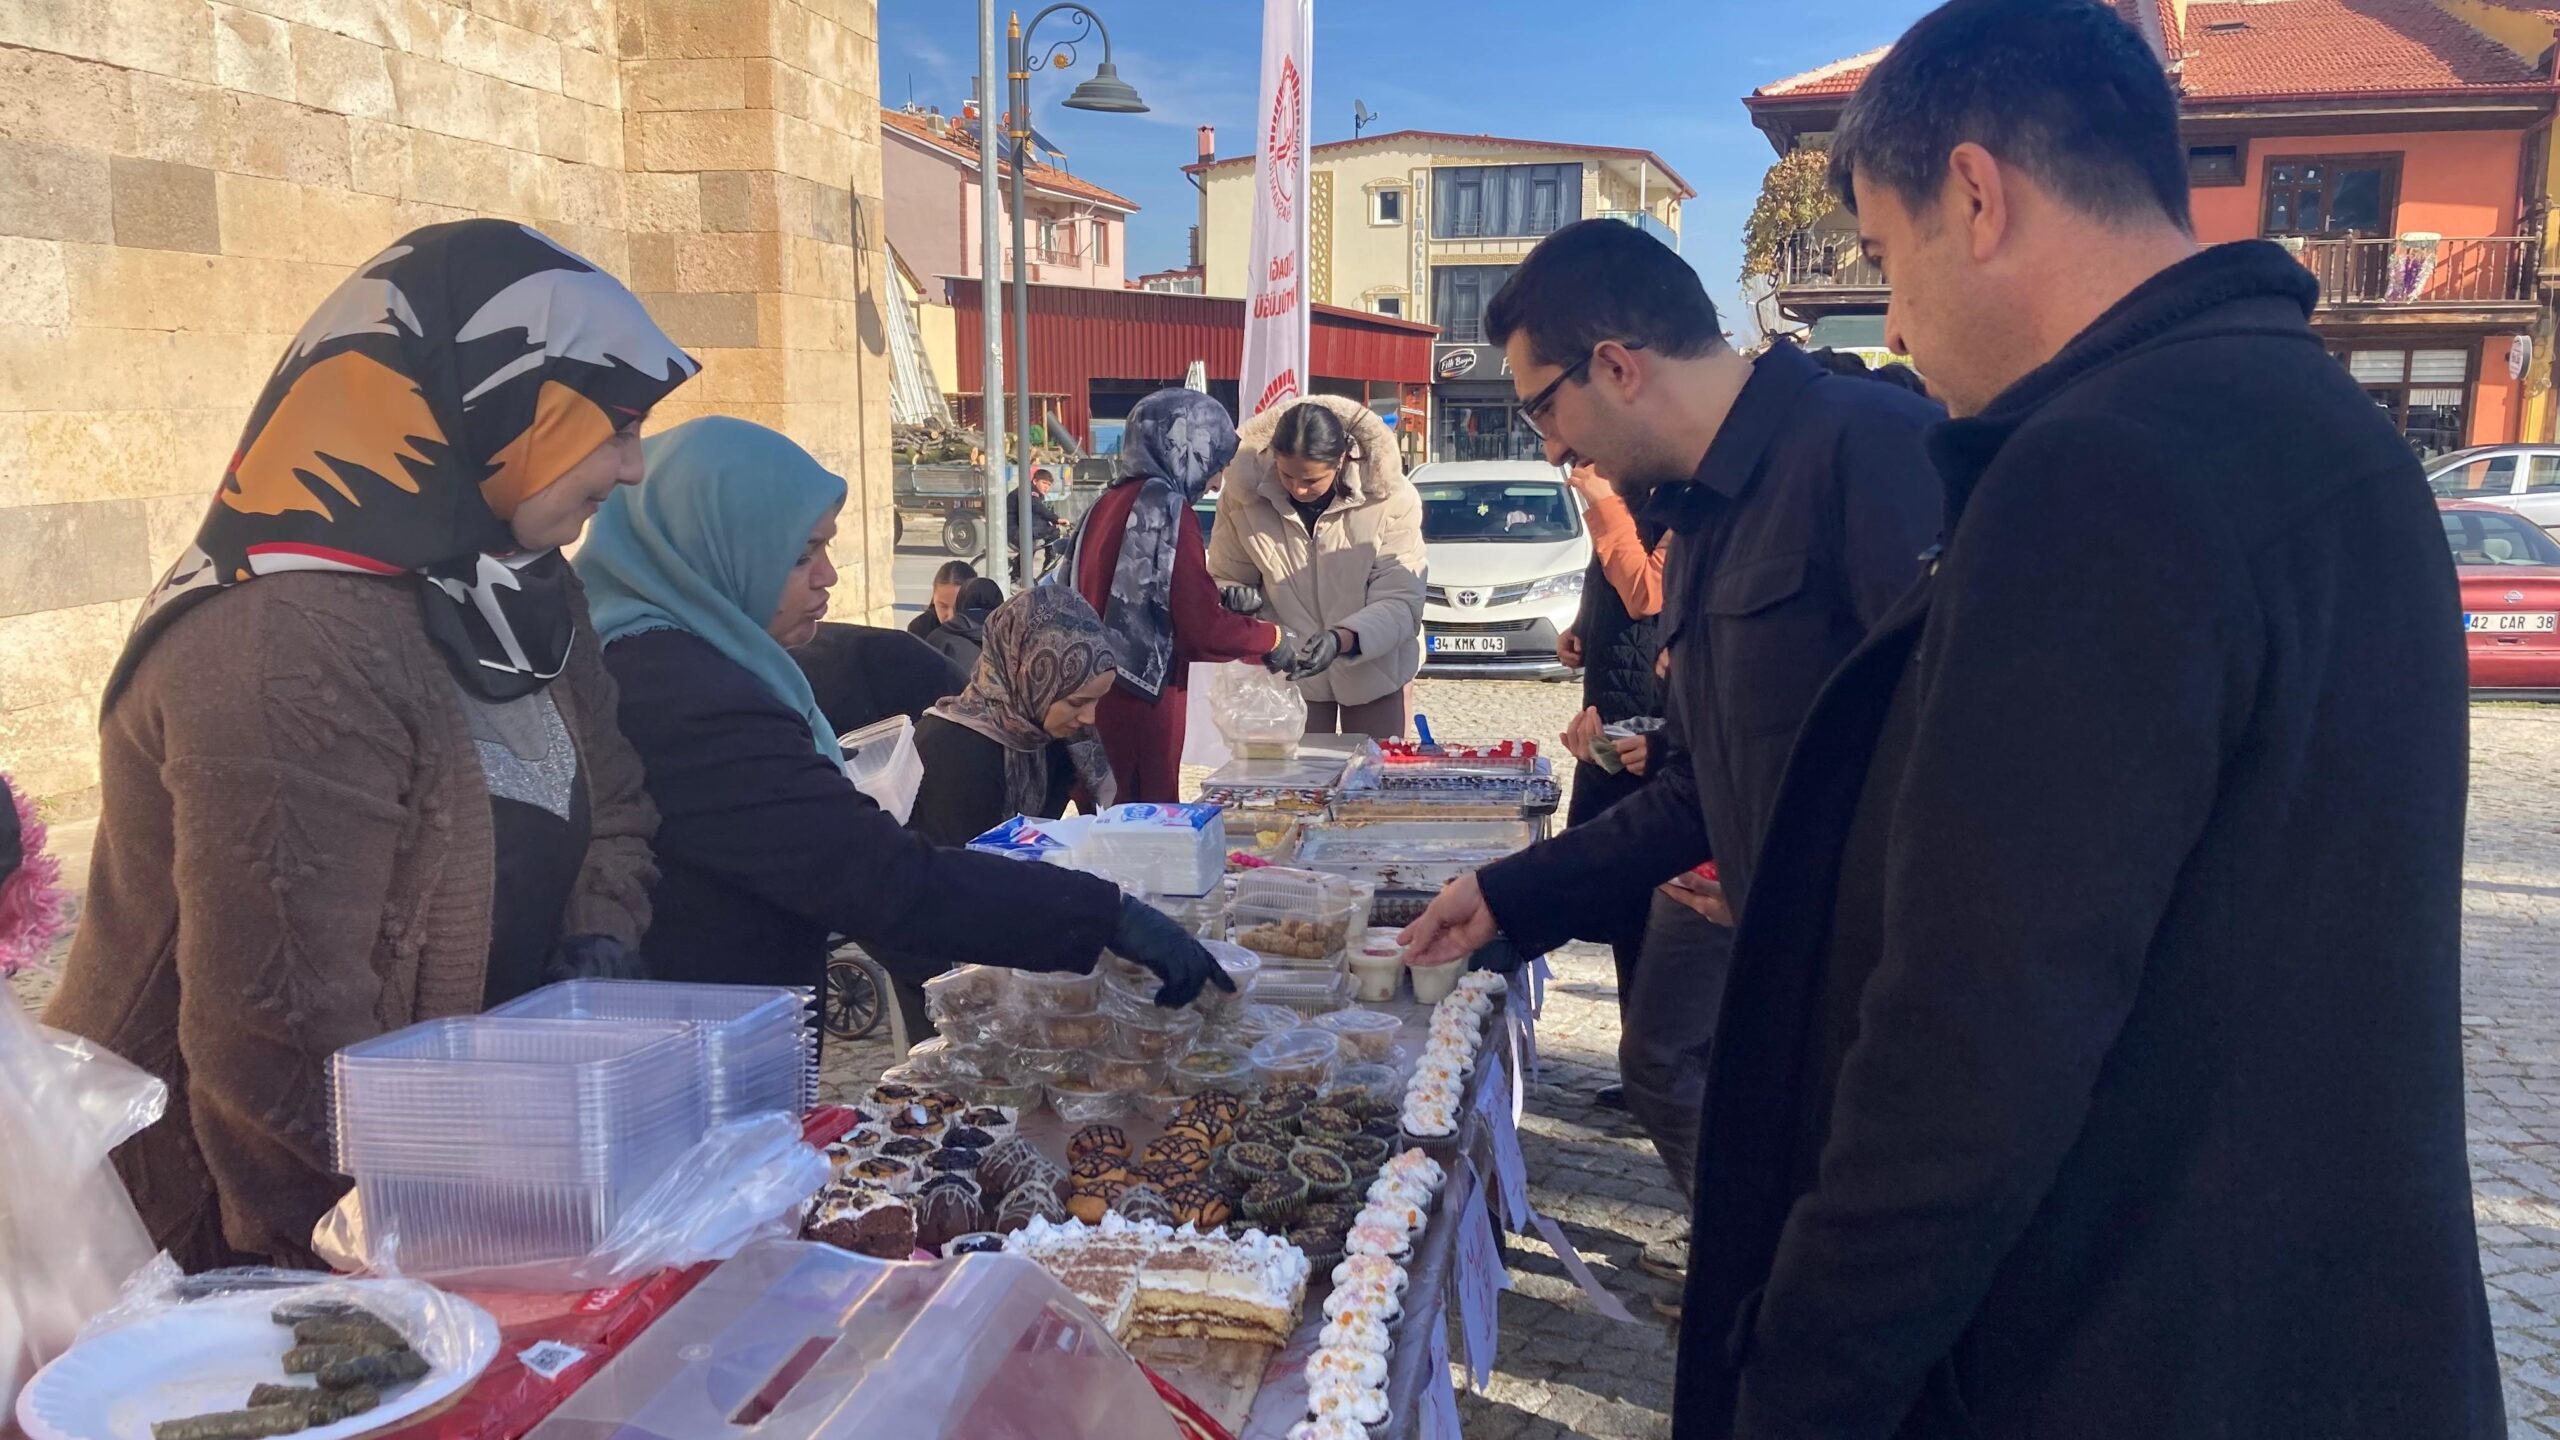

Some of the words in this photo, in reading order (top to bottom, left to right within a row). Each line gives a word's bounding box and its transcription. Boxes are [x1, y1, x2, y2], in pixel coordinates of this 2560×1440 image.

[2470, 616, 2489, 629] 42
[2499, 616, 2526, 629] CAR
[2536, 616, 2555, 629] 38
[1435, 637, 1449, 650] 34
[1454, 637, 1476, 650] KMK
[1481, 637, 1504, 650] 043
